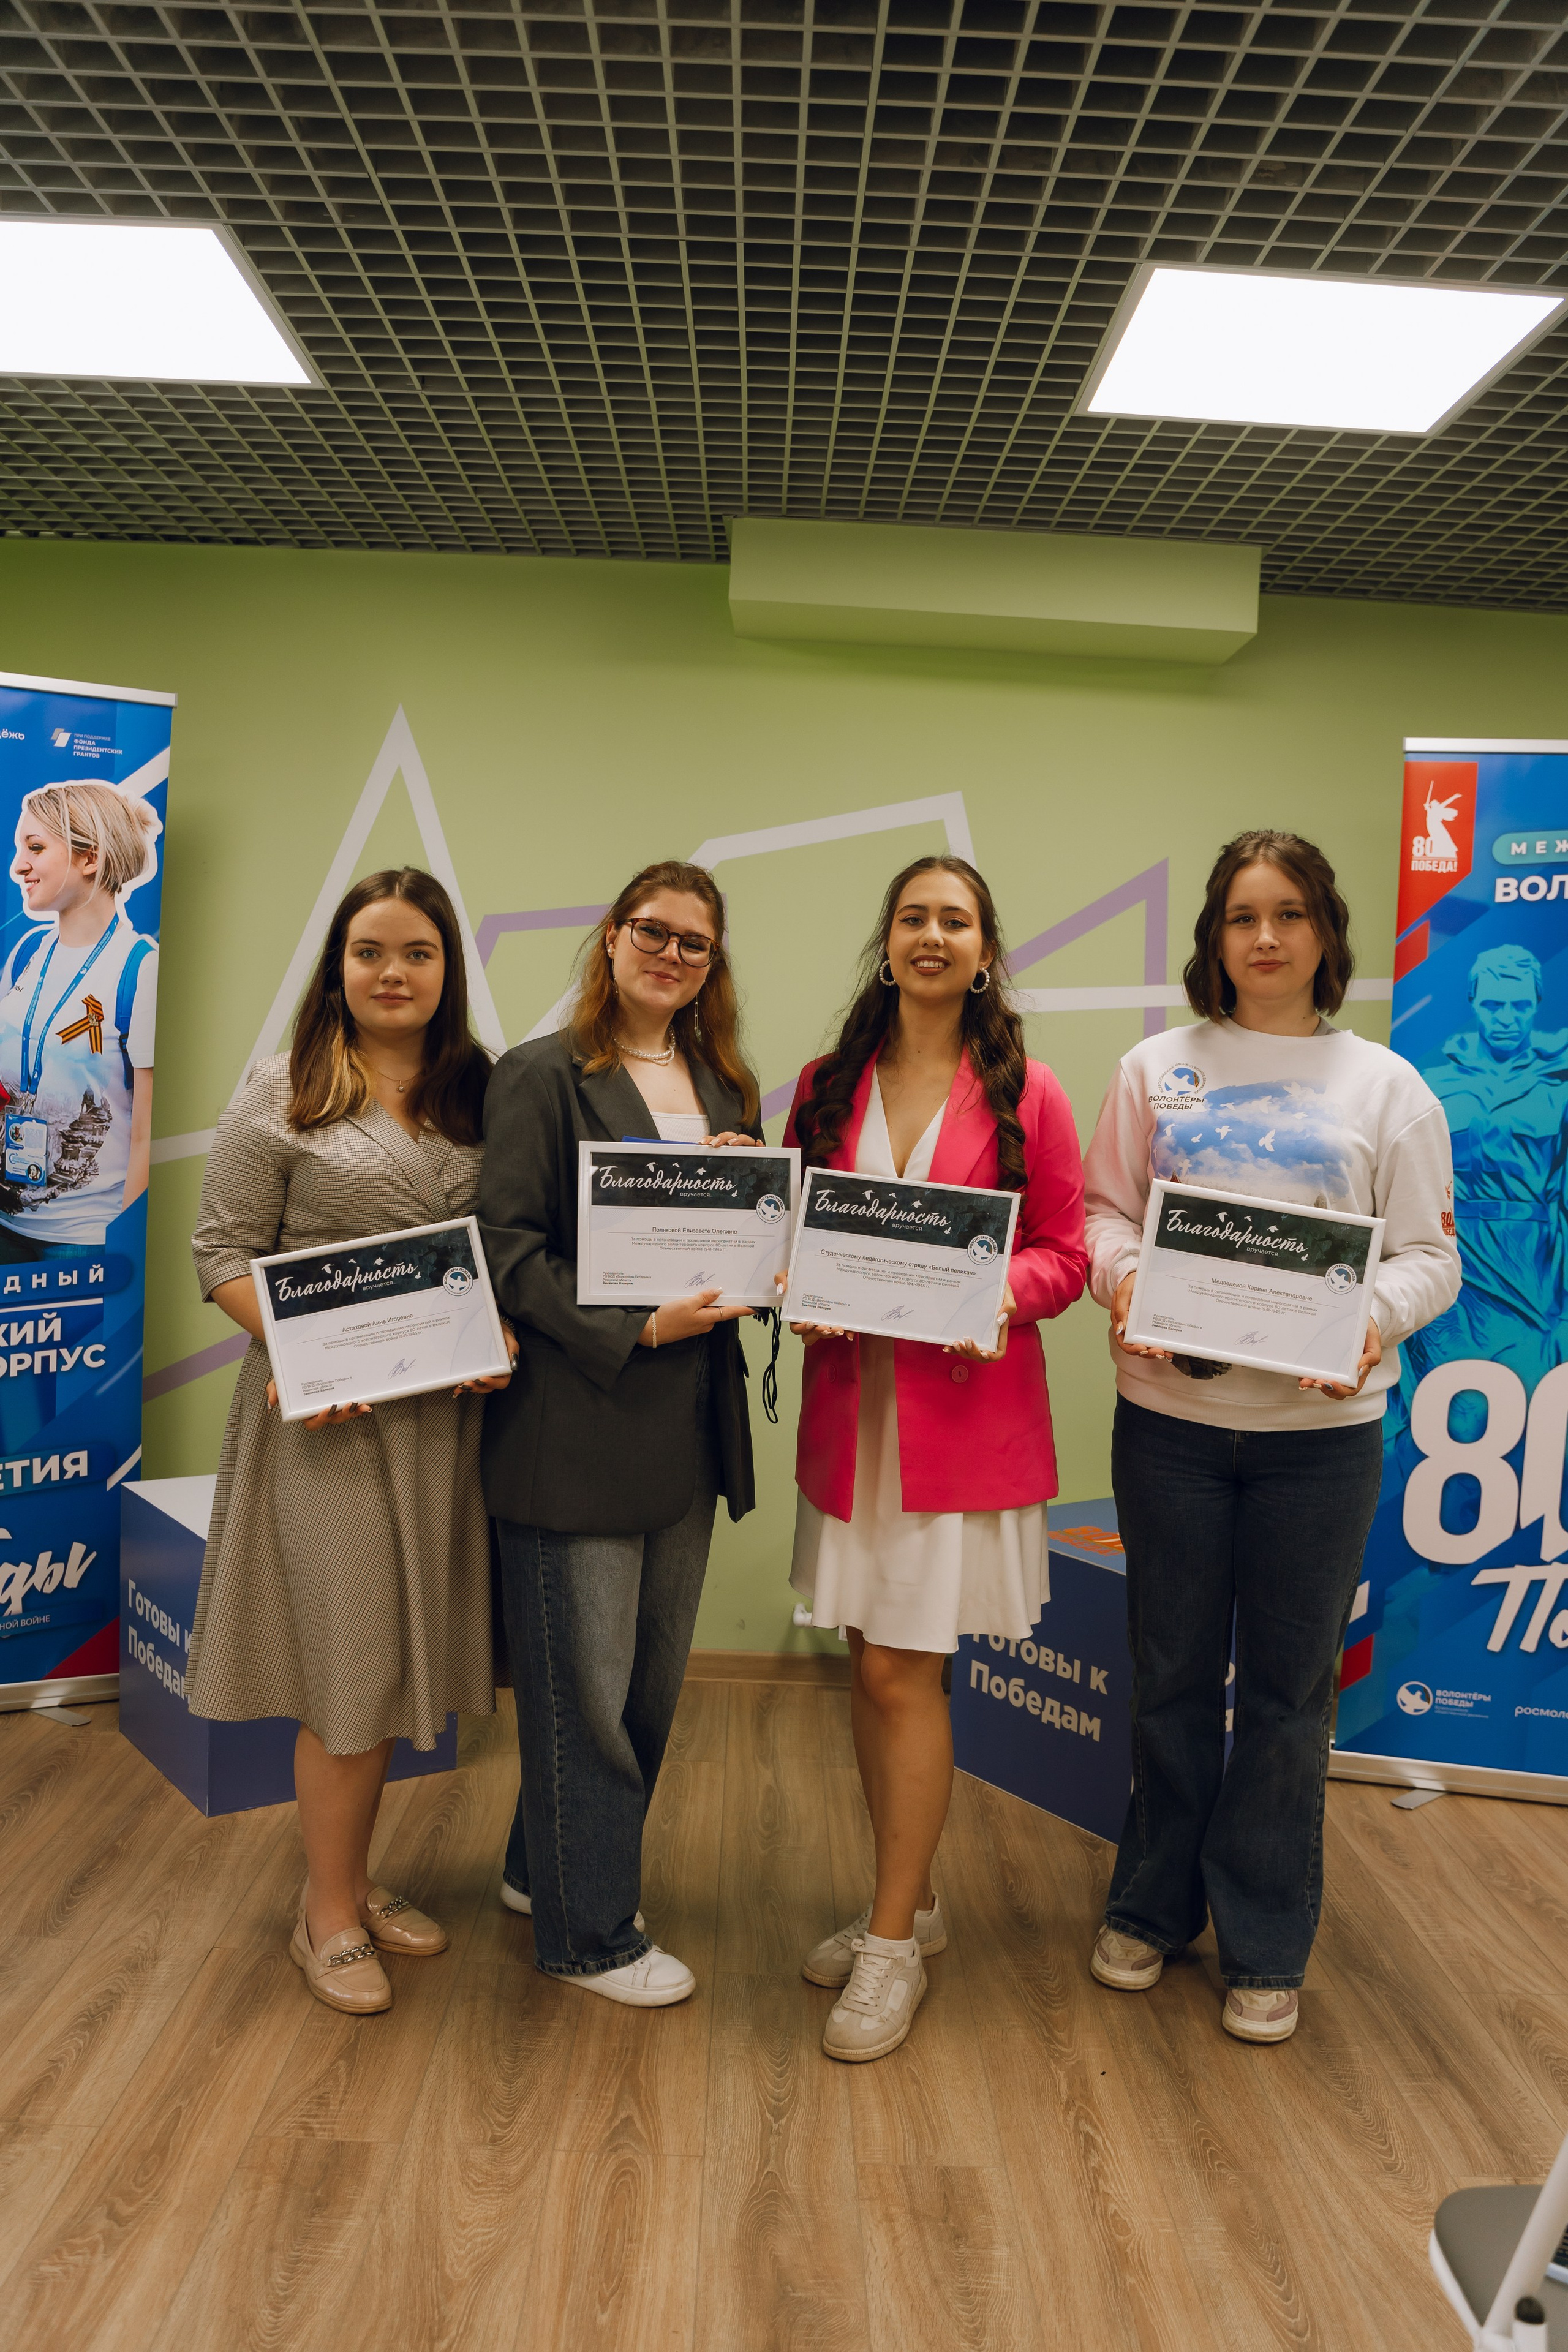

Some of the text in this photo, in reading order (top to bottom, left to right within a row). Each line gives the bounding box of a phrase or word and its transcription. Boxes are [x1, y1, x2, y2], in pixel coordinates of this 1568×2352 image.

[0, 728, 25, 740] ёжь
[74, 745, 123, 755] ПРЕЗИДЕНТСКИХ
[1411, 860, 1458, 873] ПОБЕДА!
[599, 1166, 737, 1196] Благодарность
[815, 1189, 951, 1227] Благодарность
[1166, 1209, 1308, 1254] Благодарность
[820, 1249, 861, 1261] Студенческому
[862, 1256, 907, 1267] педагогическому
[274, 1262, 419, 1301] Благодарность
[1211, 1277, 1312, 1301] Медведевой Карине Александровне
[342, 1322, 371, 1332] Астаховой
[386, 1314, 413, 1322] Игоревне
[0, 1344, 107, 1378] РПУС
[0, 1450, 88, 1490] ТИЯ
[21, 1615, 50, 1627] ВОЙНЕ
[129, 1578, 180, 1648] Готовы
[1090, 1665, 1109, 1695] к
[970, 1659, 1101, 1742] Победам
[1435, 1697, 1474, 1708] ПОБЕДЫ
[1436, 1690, 1491, 1702] ВОЛОНТЁРЫ
